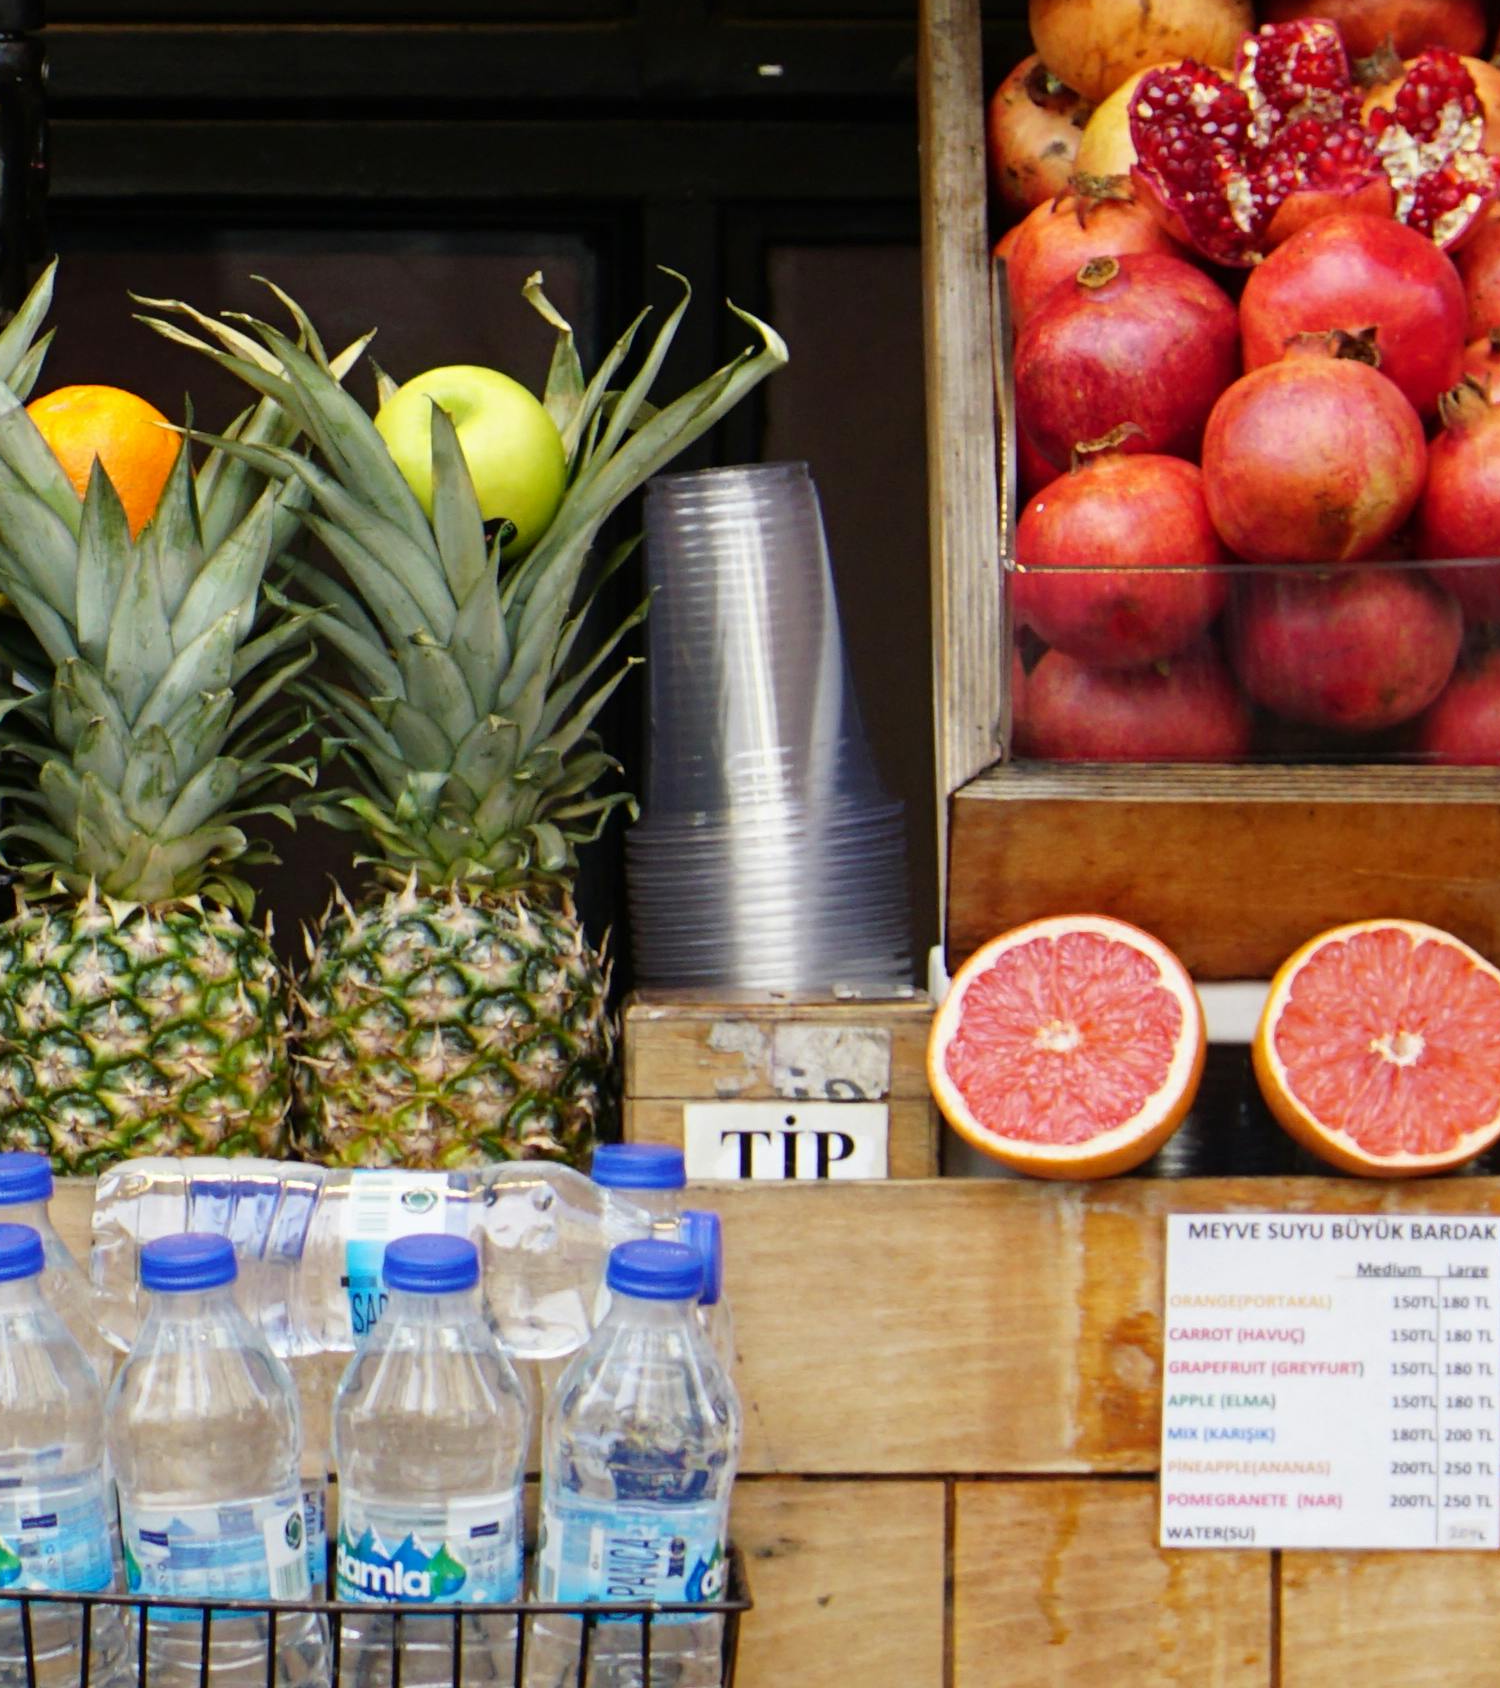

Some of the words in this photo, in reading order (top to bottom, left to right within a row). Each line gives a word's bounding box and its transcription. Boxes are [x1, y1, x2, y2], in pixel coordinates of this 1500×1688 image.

[720, 1114, 856, 1179] TİP
[1188, 1222, 1260, 1240] MEYVE
[1267, 1223, 1323, 1240] SUYU
[1332, 1218, 1403, 1240] BÜYÜK
[1411, 1223, 1496, 1241] BARDAK
[1357, 1263, 1422, 1278] Medium
[1447, 1264, 1489, 1280] Large
[1442, 1296, 1469, 1310] 180
[1474, 1296, 1491, 1310] TL
[1168, 1328, 1232, 1342] CARROT
[1237, 1327, 1305, 1345] (HAVUÇ)
[1445, 1330, 1472, 1343] 180
[1478, 1330, 1494, 1343] TL
[1168, 1361, 1267, 1375] GRAPEFRUIT
[1271, 1361, 1365, 1378] (GREYFURT)
[1445, 1363, 1472, 1376] 180
[1478, 1363, 1494, 1376] TL
[1167, 1394, 1216, 1408] APPLE
[1220, 1394, 1277, 1411] (ELMA)
[1445, 1396, 1473, 1409] 180
[1479, 1396, 1495, 1409] TL
[1167, 1427, 1198, 1441] MIX
[1444, 1429, 1473, 1442] 200
[1478, 1429, 1494, 1442] TL
[1444, 1462, 1473, 1476] 250
[1477, 1462, 1494, 1476] TL
[1167, 1494, 1288, 1507] POMEGRANETE
[1297, 1493, 1343, 1511] (NAR)
[1443, 1495, 1472, 1509] 250
[1477, 1495, 1493, 1509] TL
[1166, 1526, 1256, 1543] WATER(SU)
